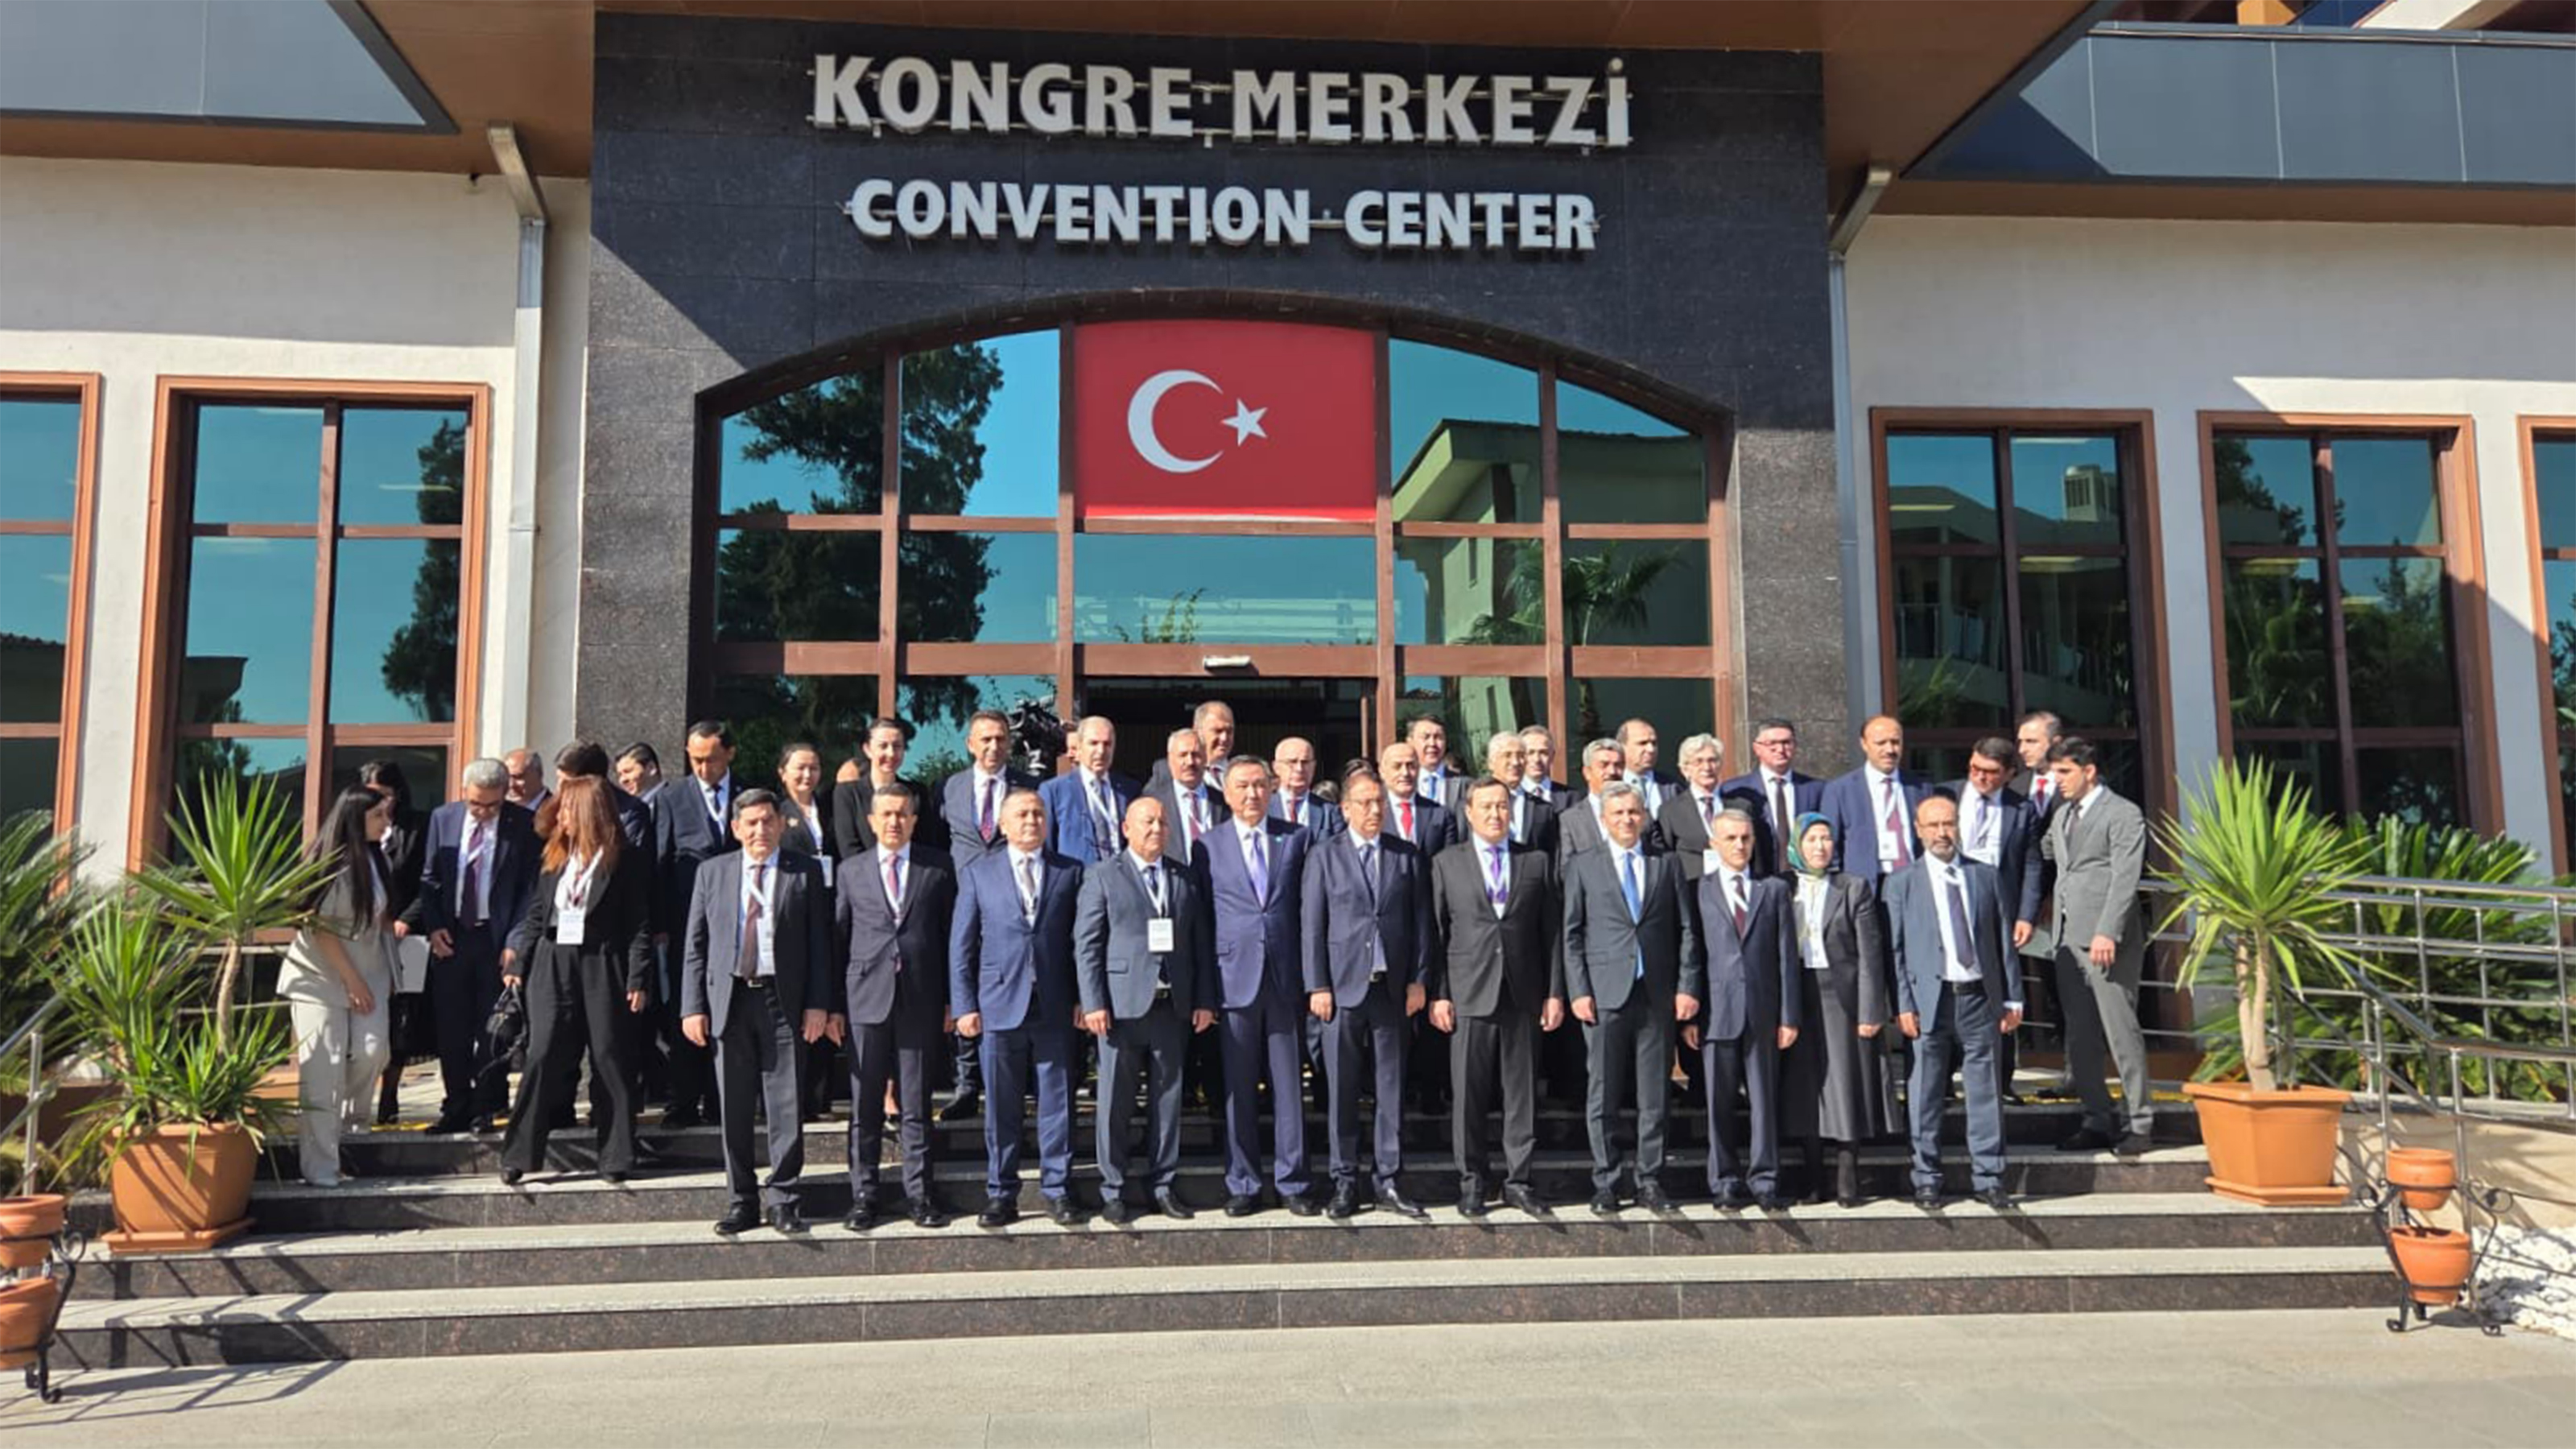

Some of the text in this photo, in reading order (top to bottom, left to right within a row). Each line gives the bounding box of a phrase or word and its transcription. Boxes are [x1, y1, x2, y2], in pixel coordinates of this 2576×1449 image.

[813, 54, 1629, 147] KONGRE MERKEZİ
[850, 179, 1596, 251] CONVENTION CENTER
